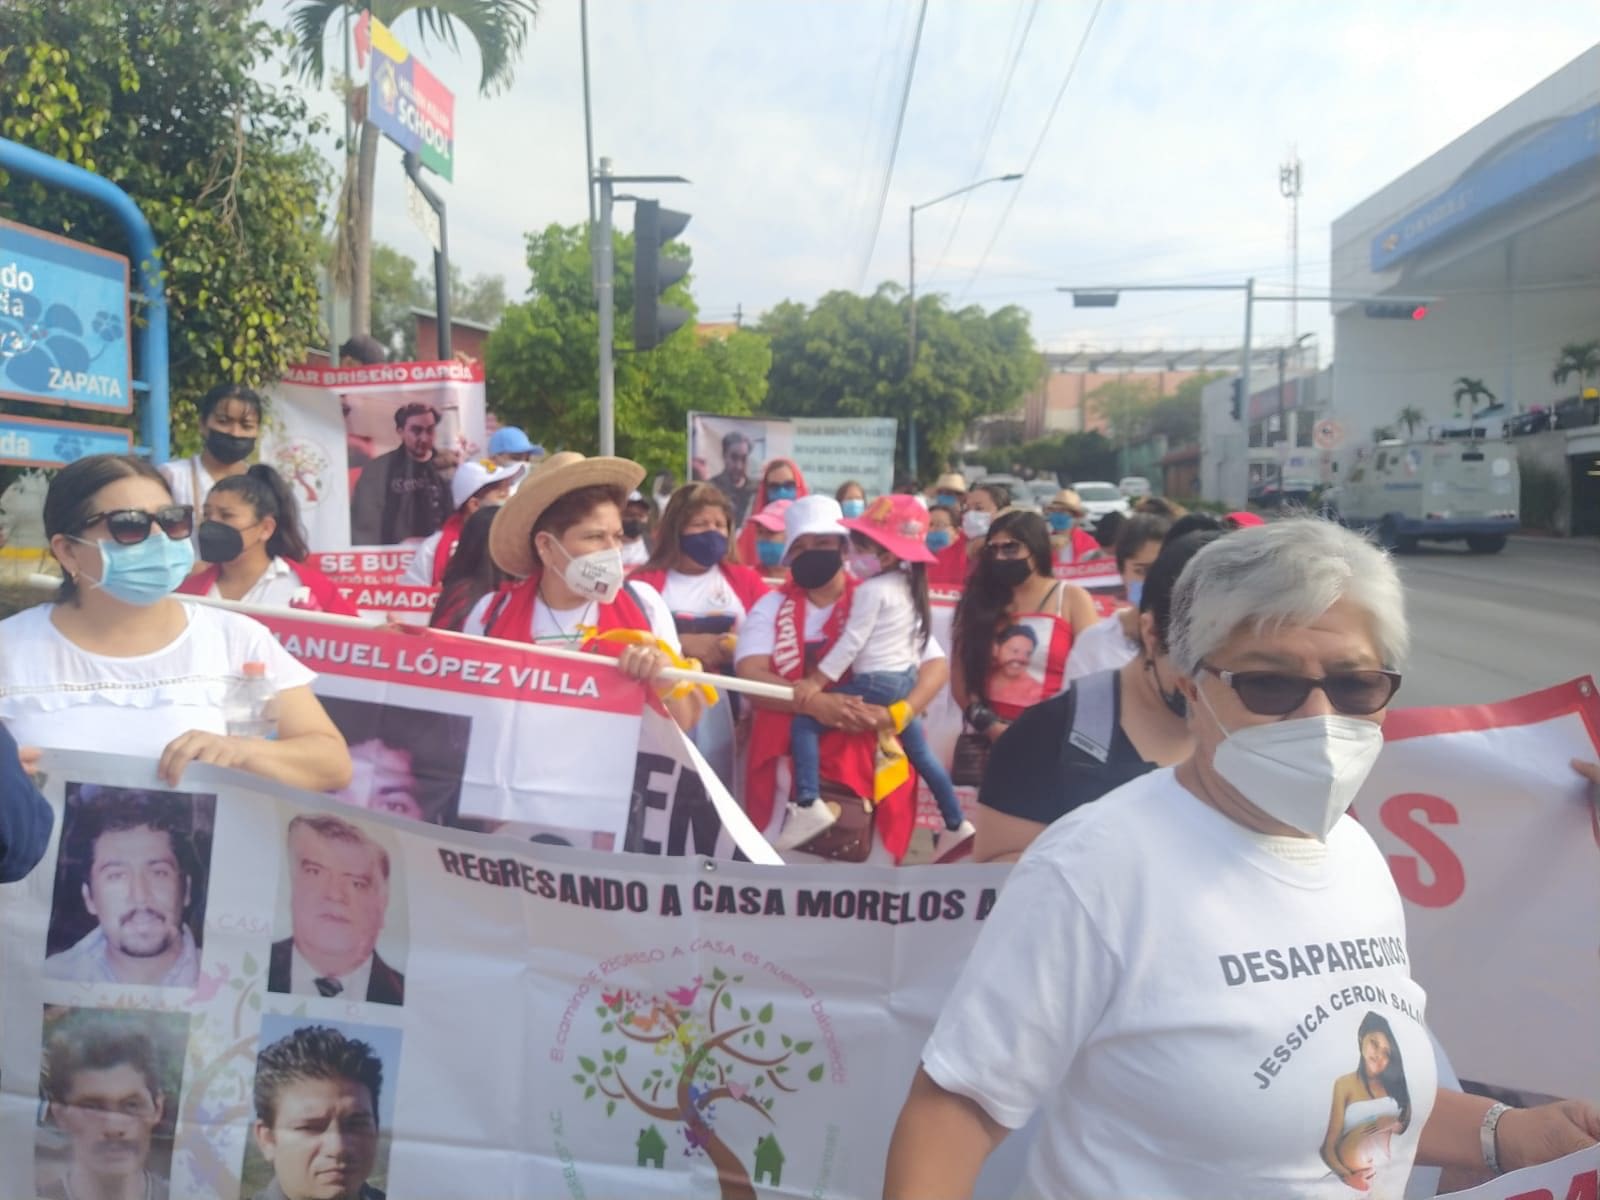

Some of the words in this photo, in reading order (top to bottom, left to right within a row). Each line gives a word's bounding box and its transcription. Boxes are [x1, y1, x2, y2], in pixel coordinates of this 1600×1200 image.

[398, 97, 450, 160] SCHOOL
[48, 368, 122, 398] ZAPATA
[323, 366, 407, 386] BRISEÑO
[320, 555, 355, 573] SE
[396, 648, 503, 686] LÓPEZ
[508, 666, 601, 698] VILLA
[437, 847, 649, 913] REGRESANDO
[660, 883, 682, 917] A
[693, 879, 785, 916] CASA
[797, 888, 966, 925] MORELOS
[671, 945, 684, 959] A
[690, 938, 735, 957] CASA
[1218, 935, 1406, 987] DESAPARECIDOS
[1253, 1005, 1330, 1090] JESSICA
[1330, 985, 1387, 1011] CERON
